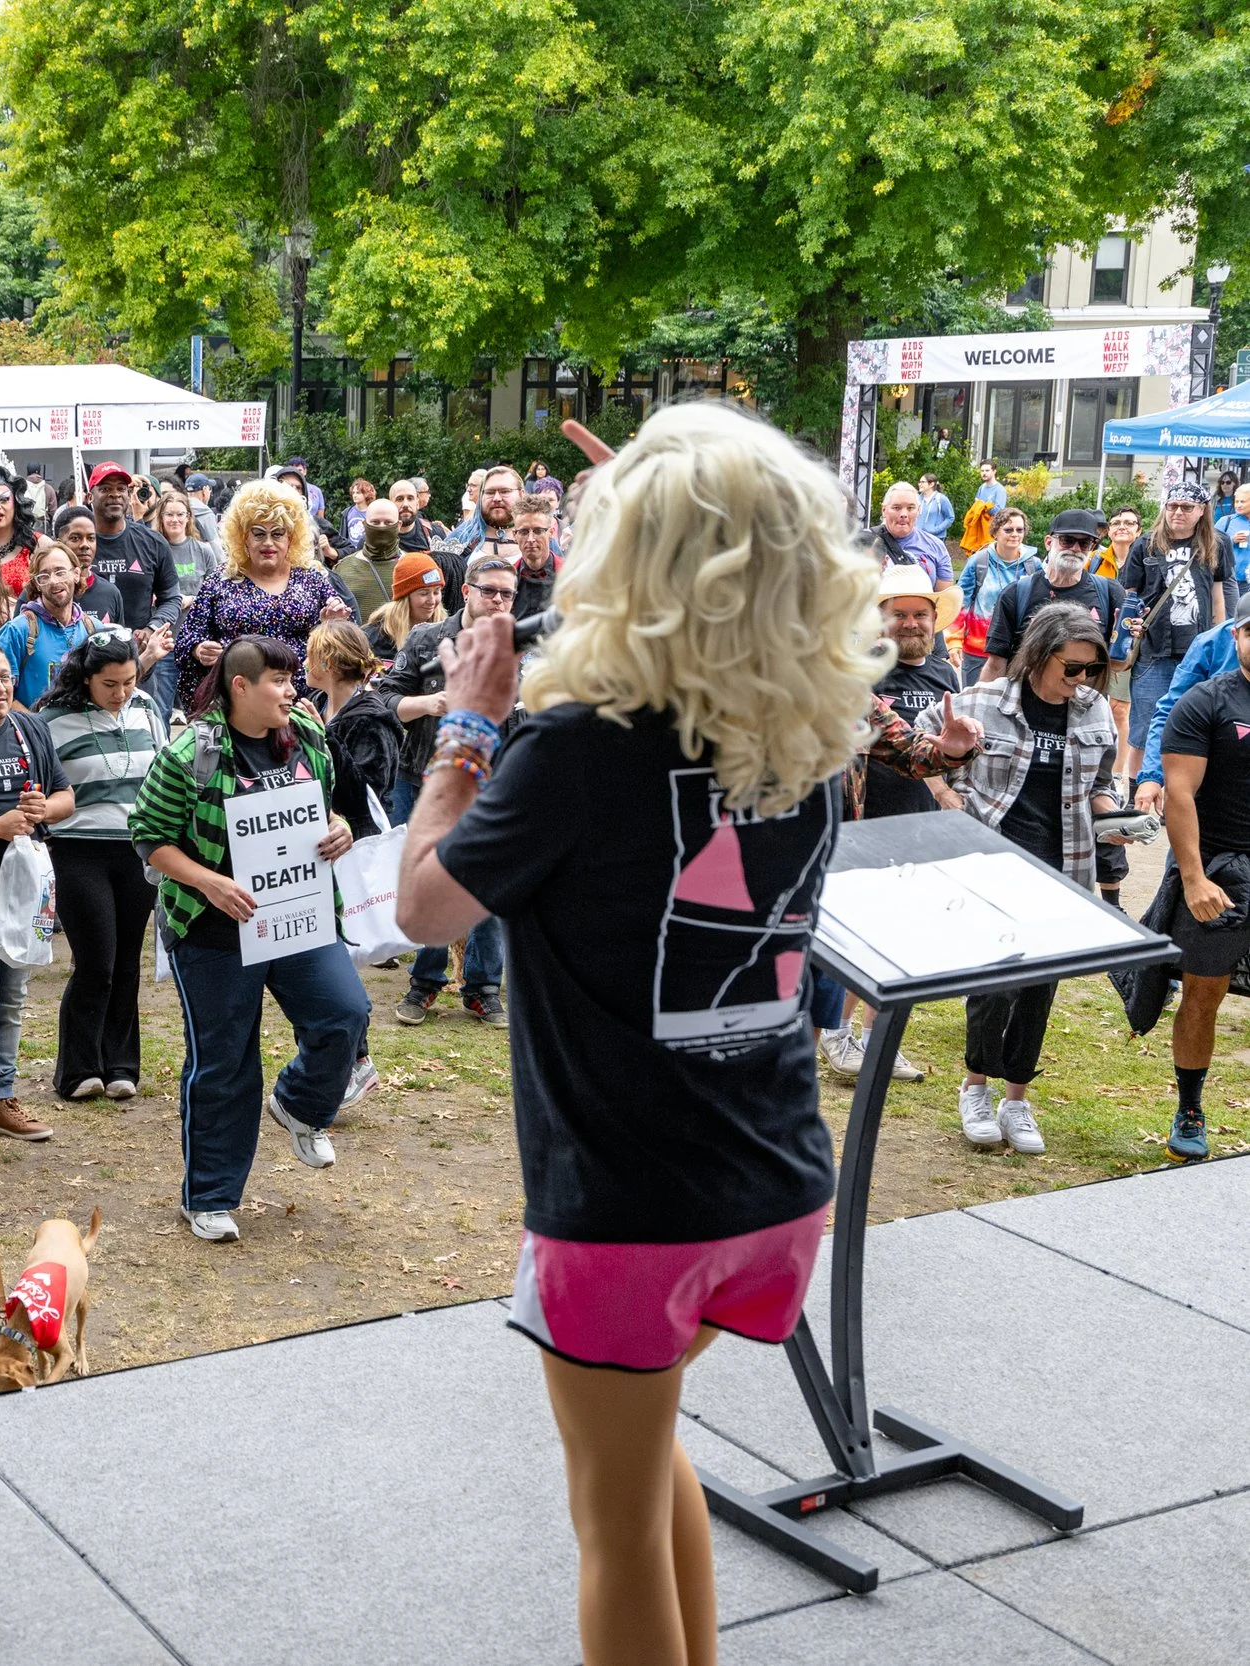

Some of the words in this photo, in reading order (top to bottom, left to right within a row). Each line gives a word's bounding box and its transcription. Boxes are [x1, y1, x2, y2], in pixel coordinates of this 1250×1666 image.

[1104, 331, 1130, 341] AIDS
[902, 342, 923, 350] AIDS
[1104, 342, 1129, 352] WALK
[902, 352, 923, 360] WALK
[964, 348, 1055, 366] WELCOME
[1103, 353, 1129, 362] NORTH
[901, 361, 923, 370] NORTH
[1103, 363, 1128, 372] WEST
[901, 371, 922, 380] WEST
[243, 408, 262, 416] AIDS
[146, 420, 200, 431] T-SHIRTS
[241, 433, 259, 441] WEST
[1110, 432, 1132, 446] kp.org
[1173, 434, 1198, 446] KAISER
[1198, 436, 1250, 449] PERMANENTE
[99, 564, 127, 573] LIFE
[1036, 737, 1066, 750] IFE
[262, 771, 294, 790] IFE
[236, 804, 320, 837] SILENCE
[252, 862, 316, 893] DEATH
[285, 910, 307, 920] WALKS
[273, 915, 318, 942] LIFE
